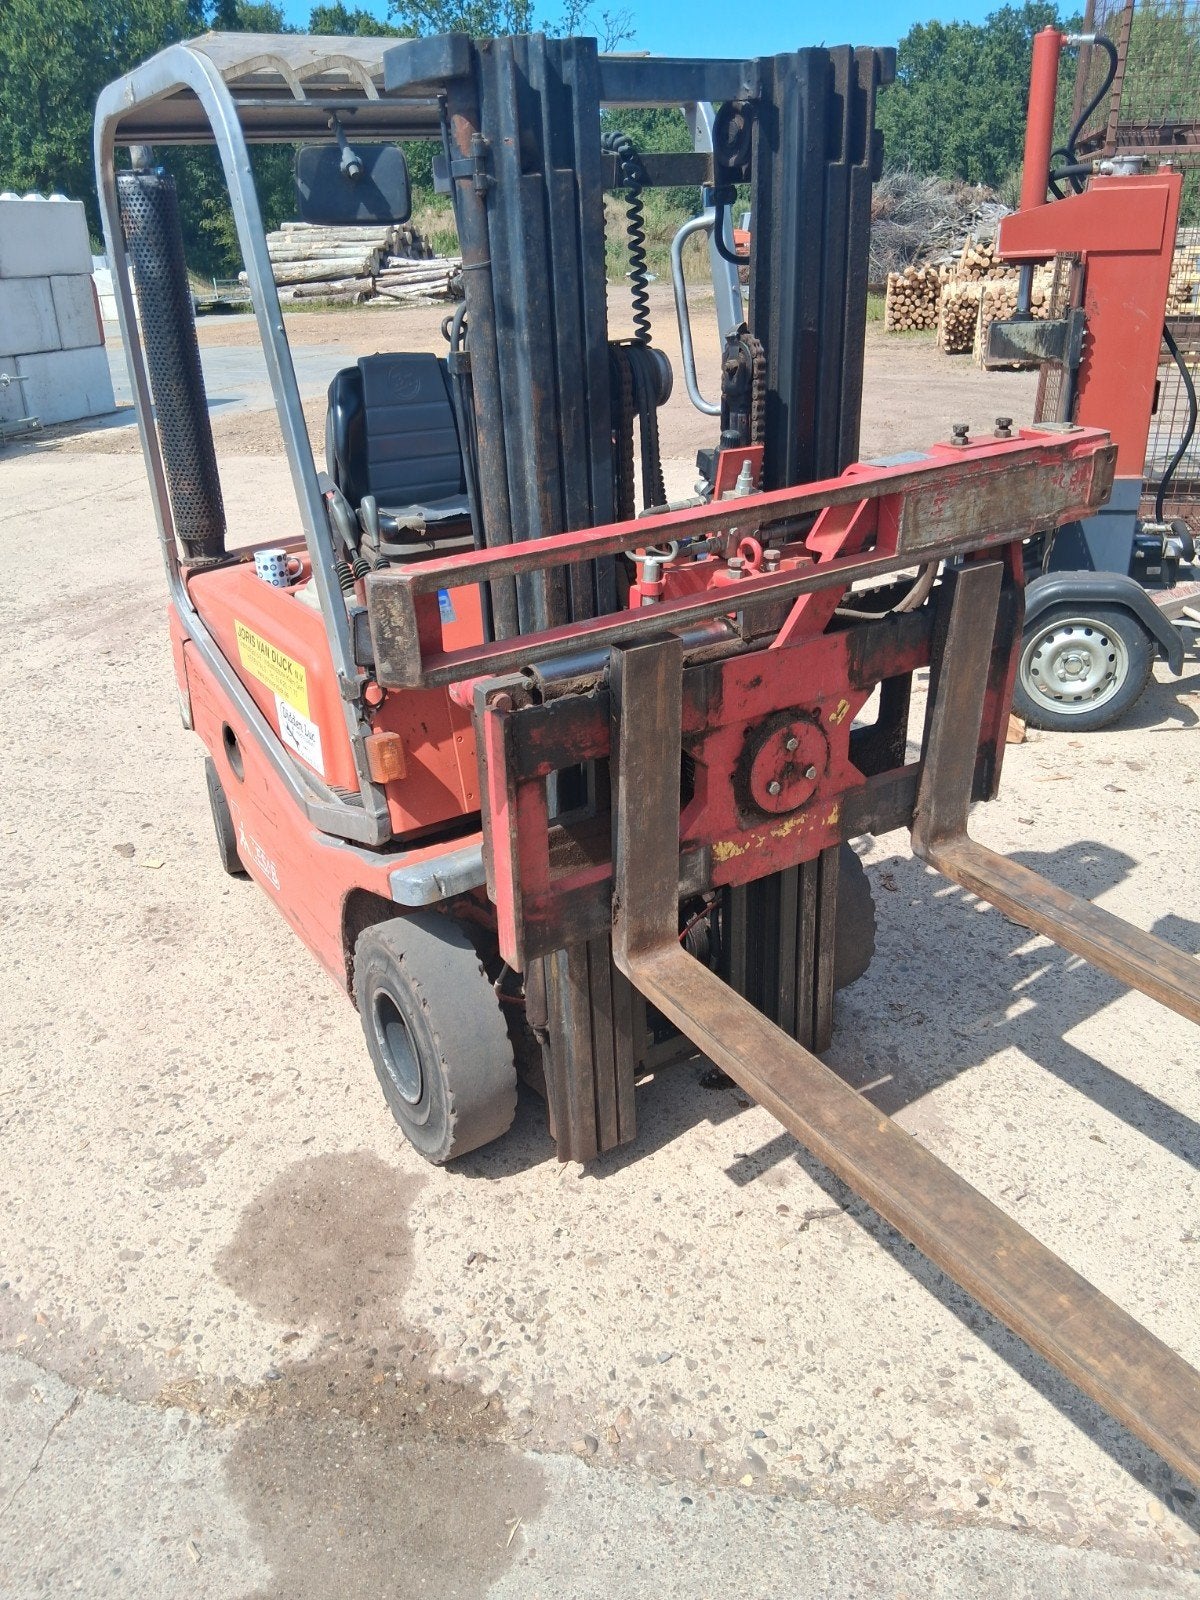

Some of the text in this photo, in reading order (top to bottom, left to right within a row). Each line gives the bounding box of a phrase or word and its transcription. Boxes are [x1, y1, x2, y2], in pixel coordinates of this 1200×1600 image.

[238, 626, 256, 647] JORIS
[257, 639, 270, 658] VAN
[271, 650, 292, 675] DIJCK
